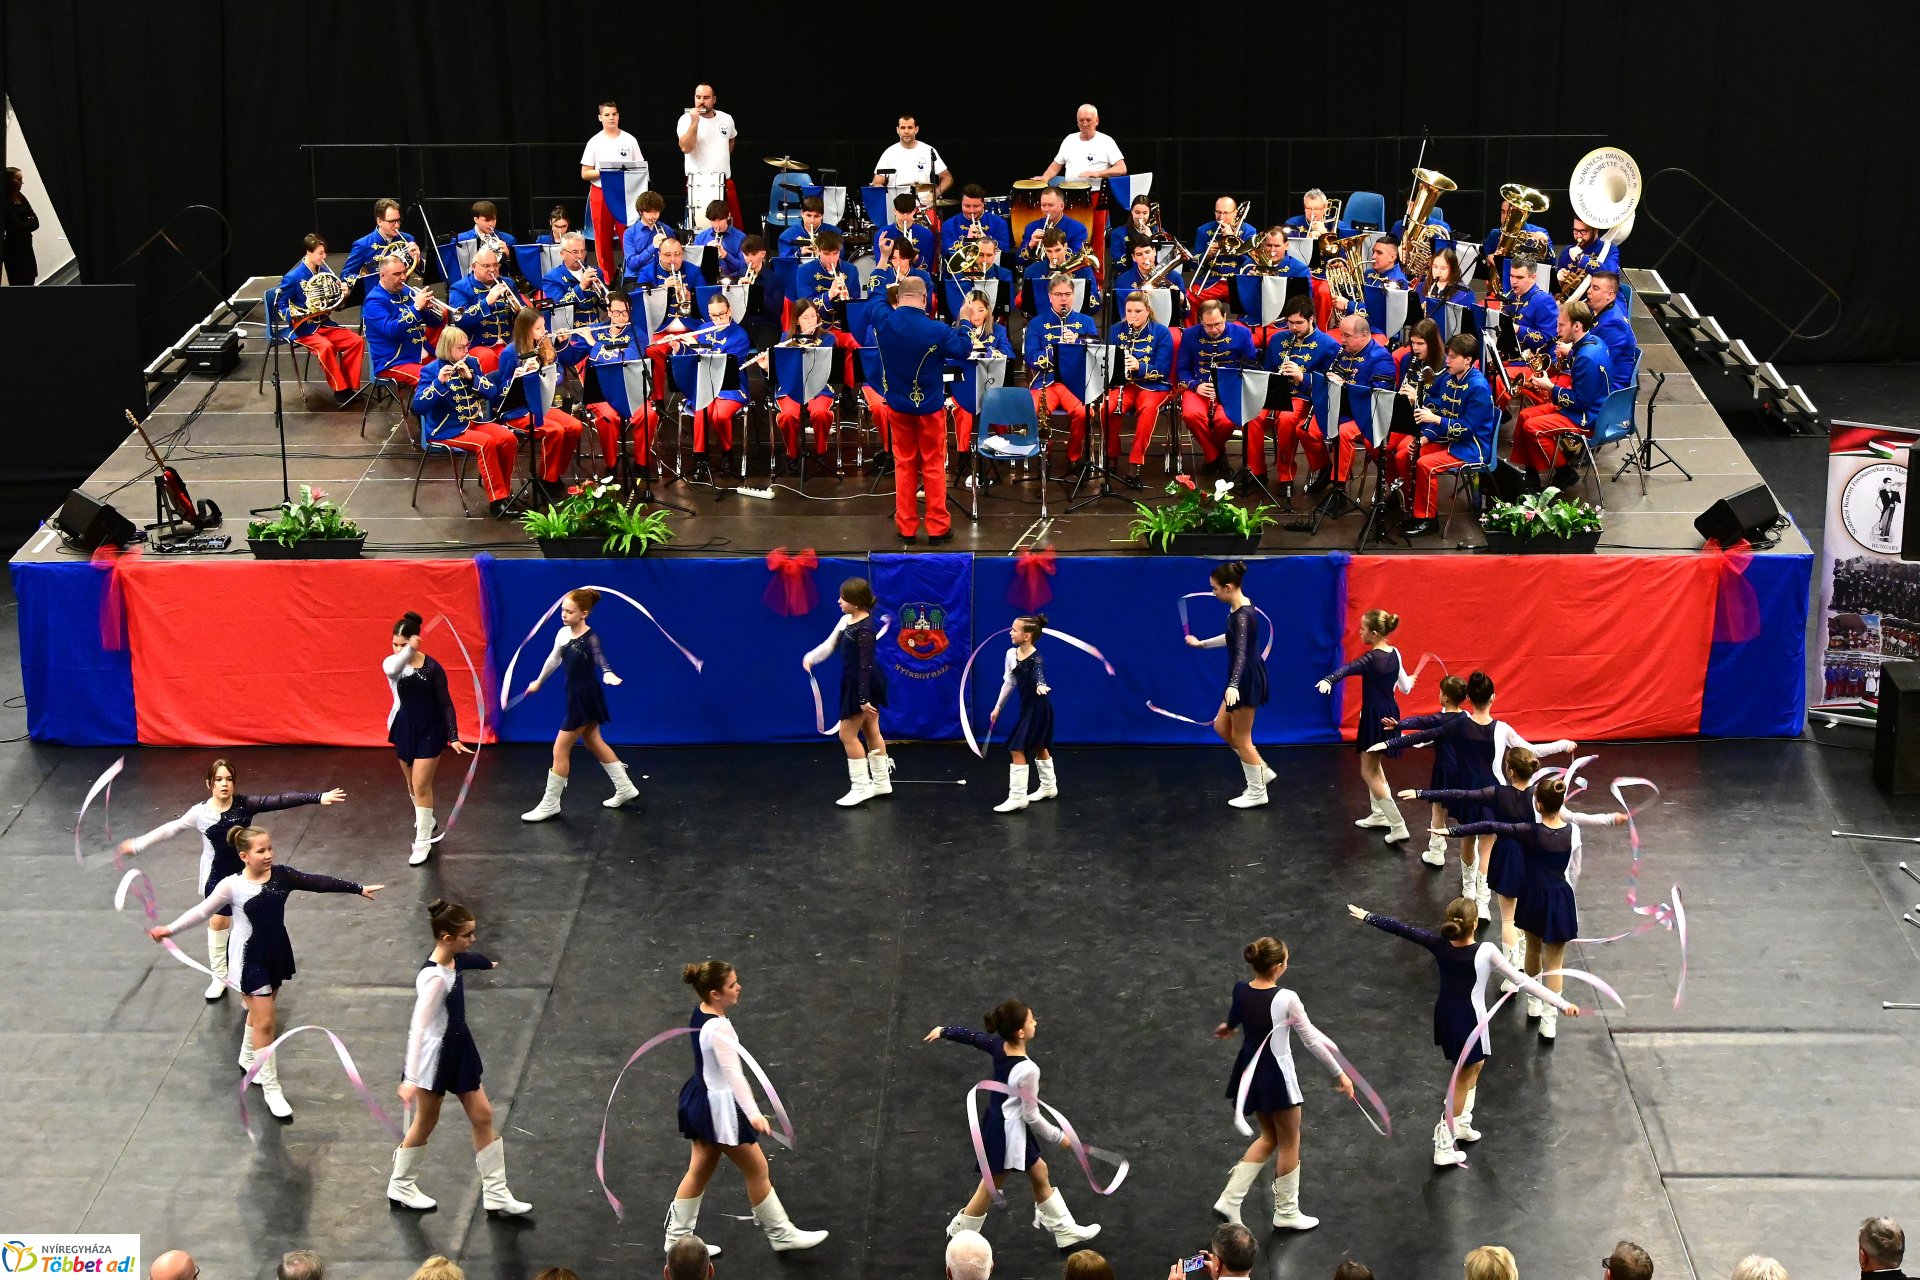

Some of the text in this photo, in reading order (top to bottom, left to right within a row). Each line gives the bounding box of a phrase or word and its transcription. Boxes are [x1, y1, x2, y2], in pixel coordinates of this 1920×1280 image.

[1579, 154, 1604, 186] SZABOLCSI
[1605, 153, 1625, 163] BRASS
[1625, 162, 1637, 180] BAND
[1588, 161, 1618, 186] MAJORETTE
[1871, 543, 1899, 551] HUNGARY
